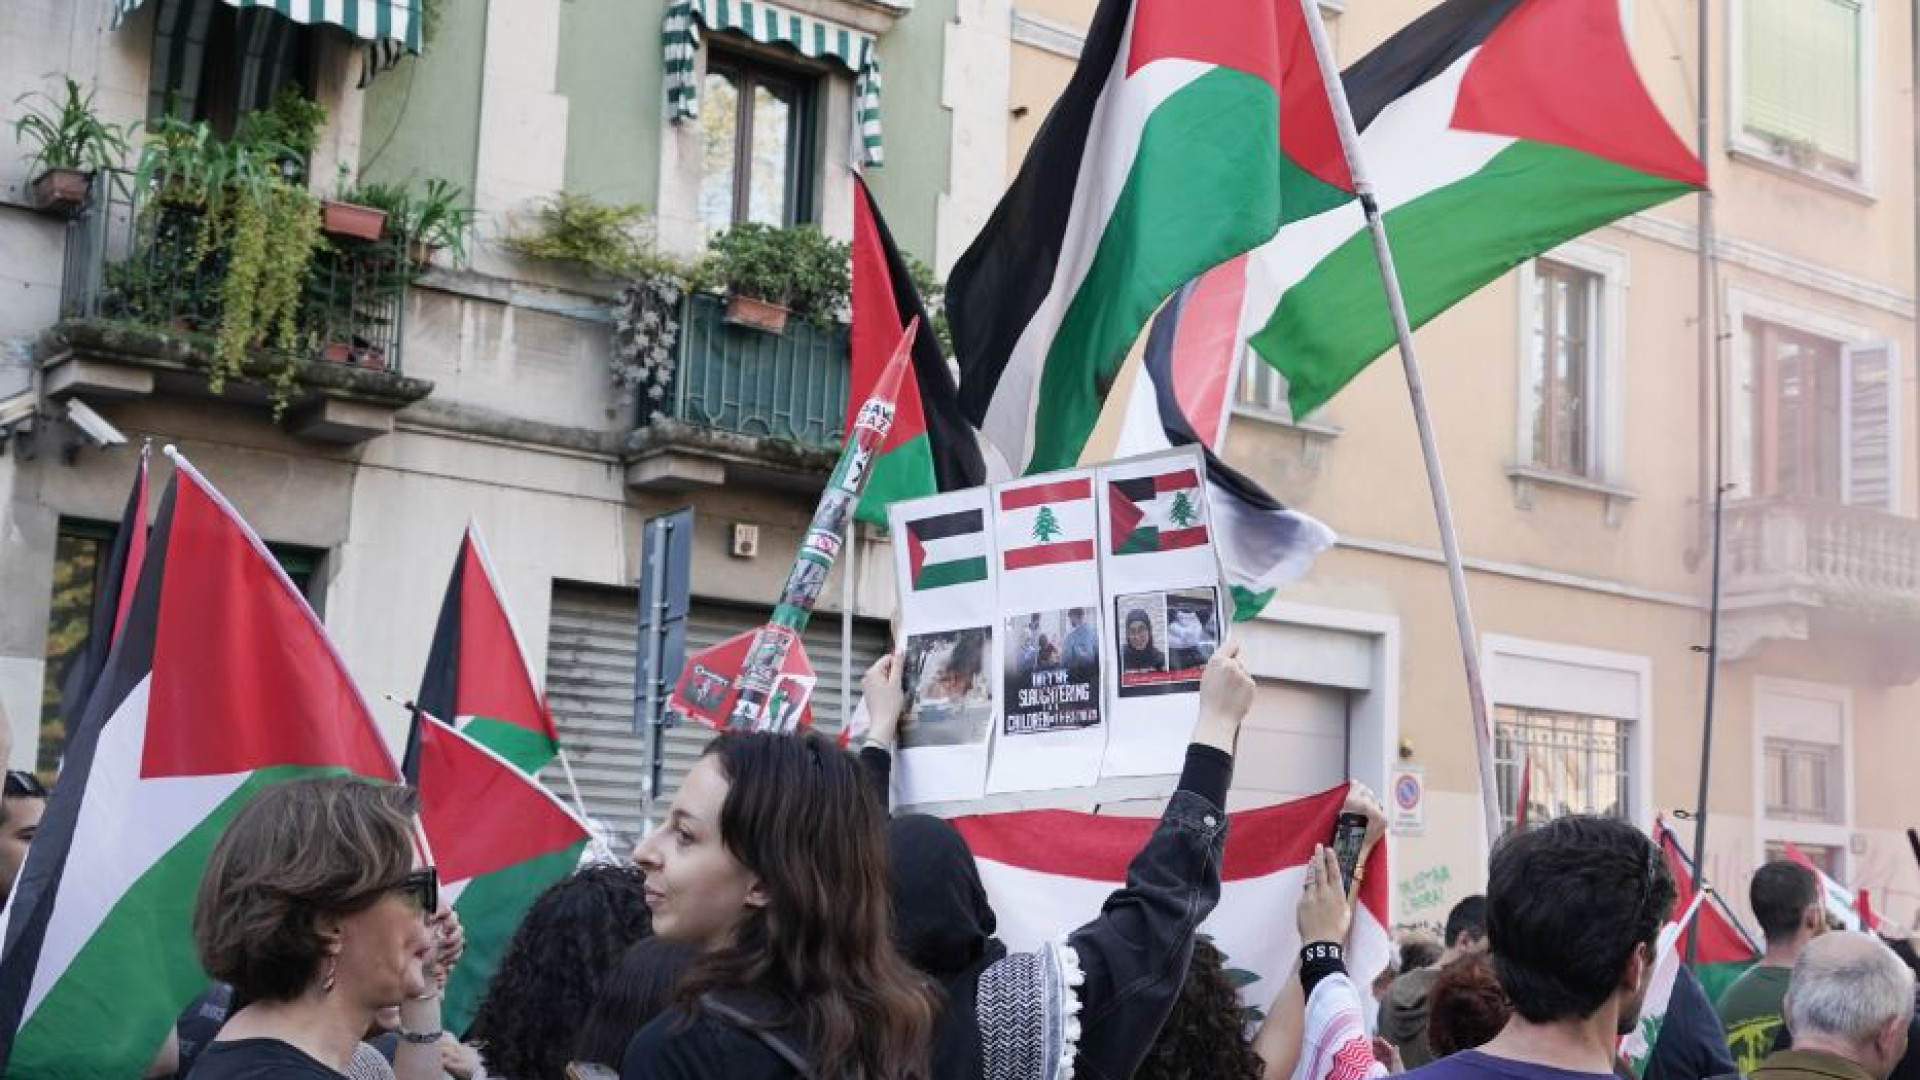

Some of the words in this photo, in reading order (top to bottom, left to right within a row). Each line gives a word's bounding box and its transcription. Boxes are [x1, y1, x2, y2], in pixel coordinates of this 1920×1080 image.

[862, 403, 892, 421] SAV
[857, 415, 888, 433] GAZ
[1018, 683, 1090, 708] SLAUGHTERING
